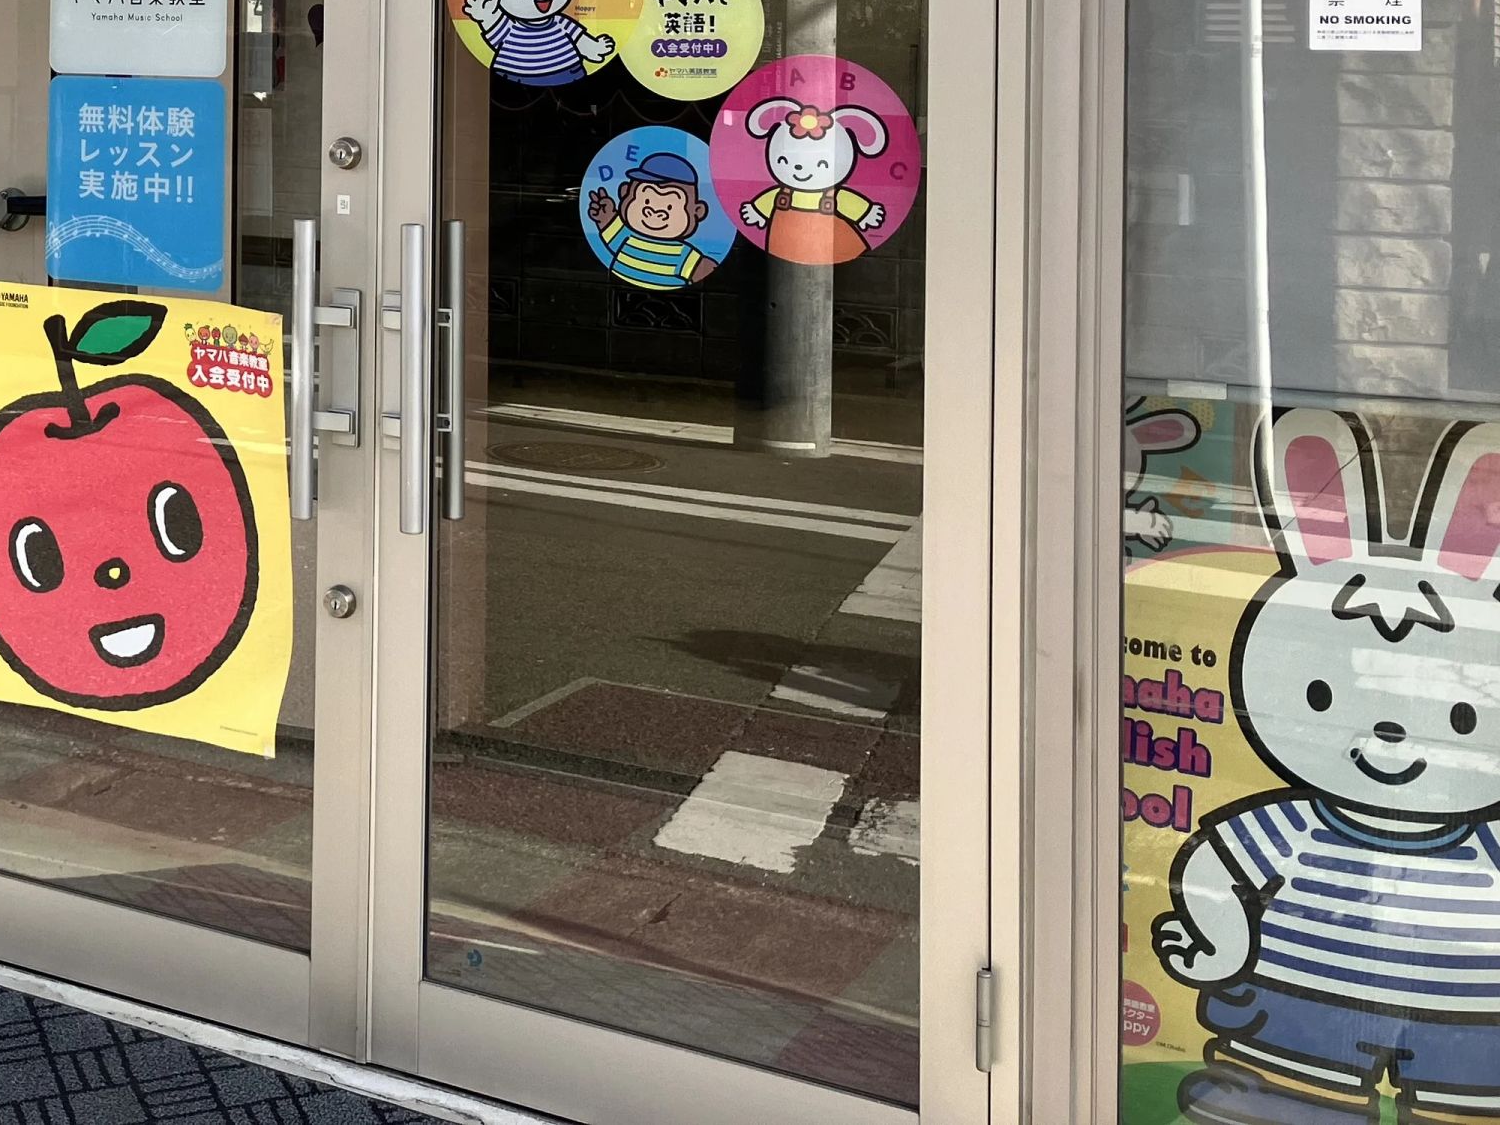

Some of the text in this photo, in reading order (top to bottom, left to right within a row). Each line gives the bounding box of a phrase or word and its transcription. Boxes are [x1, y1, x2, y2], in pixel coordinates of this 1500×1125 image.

[91, 13, 183, 22] Yamaha Music School
[664, 12, 715, 34] 英語!
[1320, 15, 1411, 24] NO SMOKING
[656, 43, 720, 54] 入会受付中!
[789, 68, 805, 88] A
[839, 72, 856, 91] B
[78, 102, 195, 138] 無料体験
[80, 139, 193, 168] レッスン
[625, 144, 640, 162] E
[598, 165, 614, 182] D
[889, 161, 907, 180] C
[78, 168, 194, 204] 実施中!!
[1, 292, 28, 303] YAMAHA
[194, 347, 268, 372] ヤマハ音楽教室
[192, 364, 271, 392] 入会受付中
[1190, 644, 1217, 667] to
